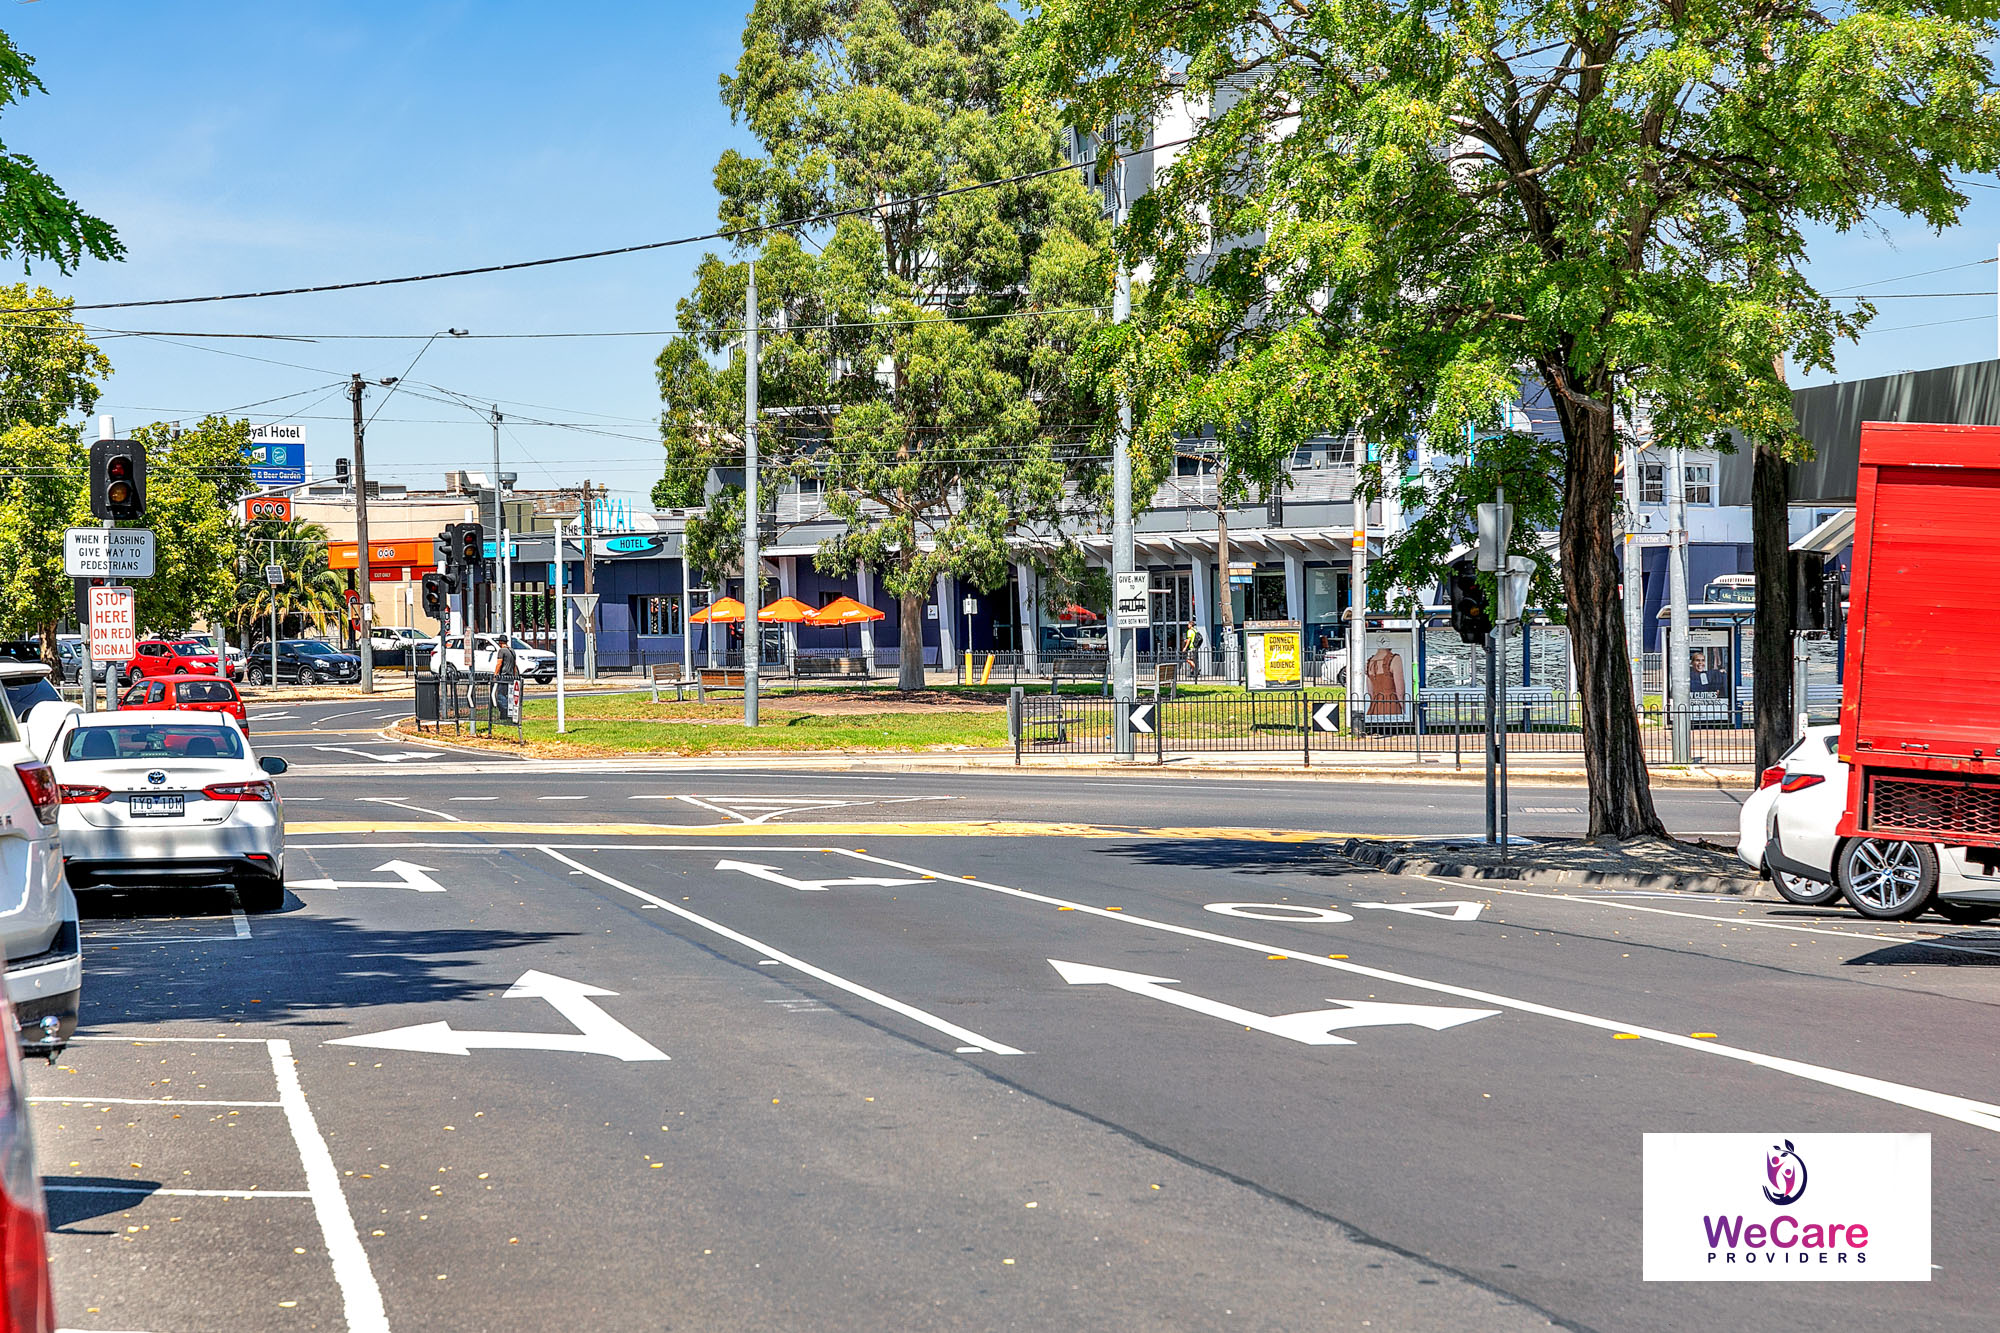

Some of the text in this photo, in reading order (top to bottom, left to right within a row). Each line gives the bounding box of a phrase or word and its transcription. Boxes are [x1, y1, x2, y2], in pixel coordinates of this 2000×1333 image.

[250, 426, 300, 440] yal Hotel
[263, 471, 278, 479] Beer
[279, 471, 301, 480] Garden
[74, 534, 146, 546] WHEN FLASHING
[620, 539, 644, 549] HOTEL
[1635, 535, 1660, 544] Fletcher
[78, 547, 141, 558] GIVE WAY TO
[80, 560, 139, 570] PEDESTRIANS
[1118, 575, 1146, 584] GIVE WAY
[95, 592, 127, 606] STOP
[95, 610, 129, 624] HERE
[93, 628, 132, 639] ON RED
[1269, 636, 1294, 644] CONNECT
[94, 644, 132, 656] SIGNAL
[1270, 661, 1295, 669] AUDIENCE
[1694, 691, 1718, 699] CLOTHES
